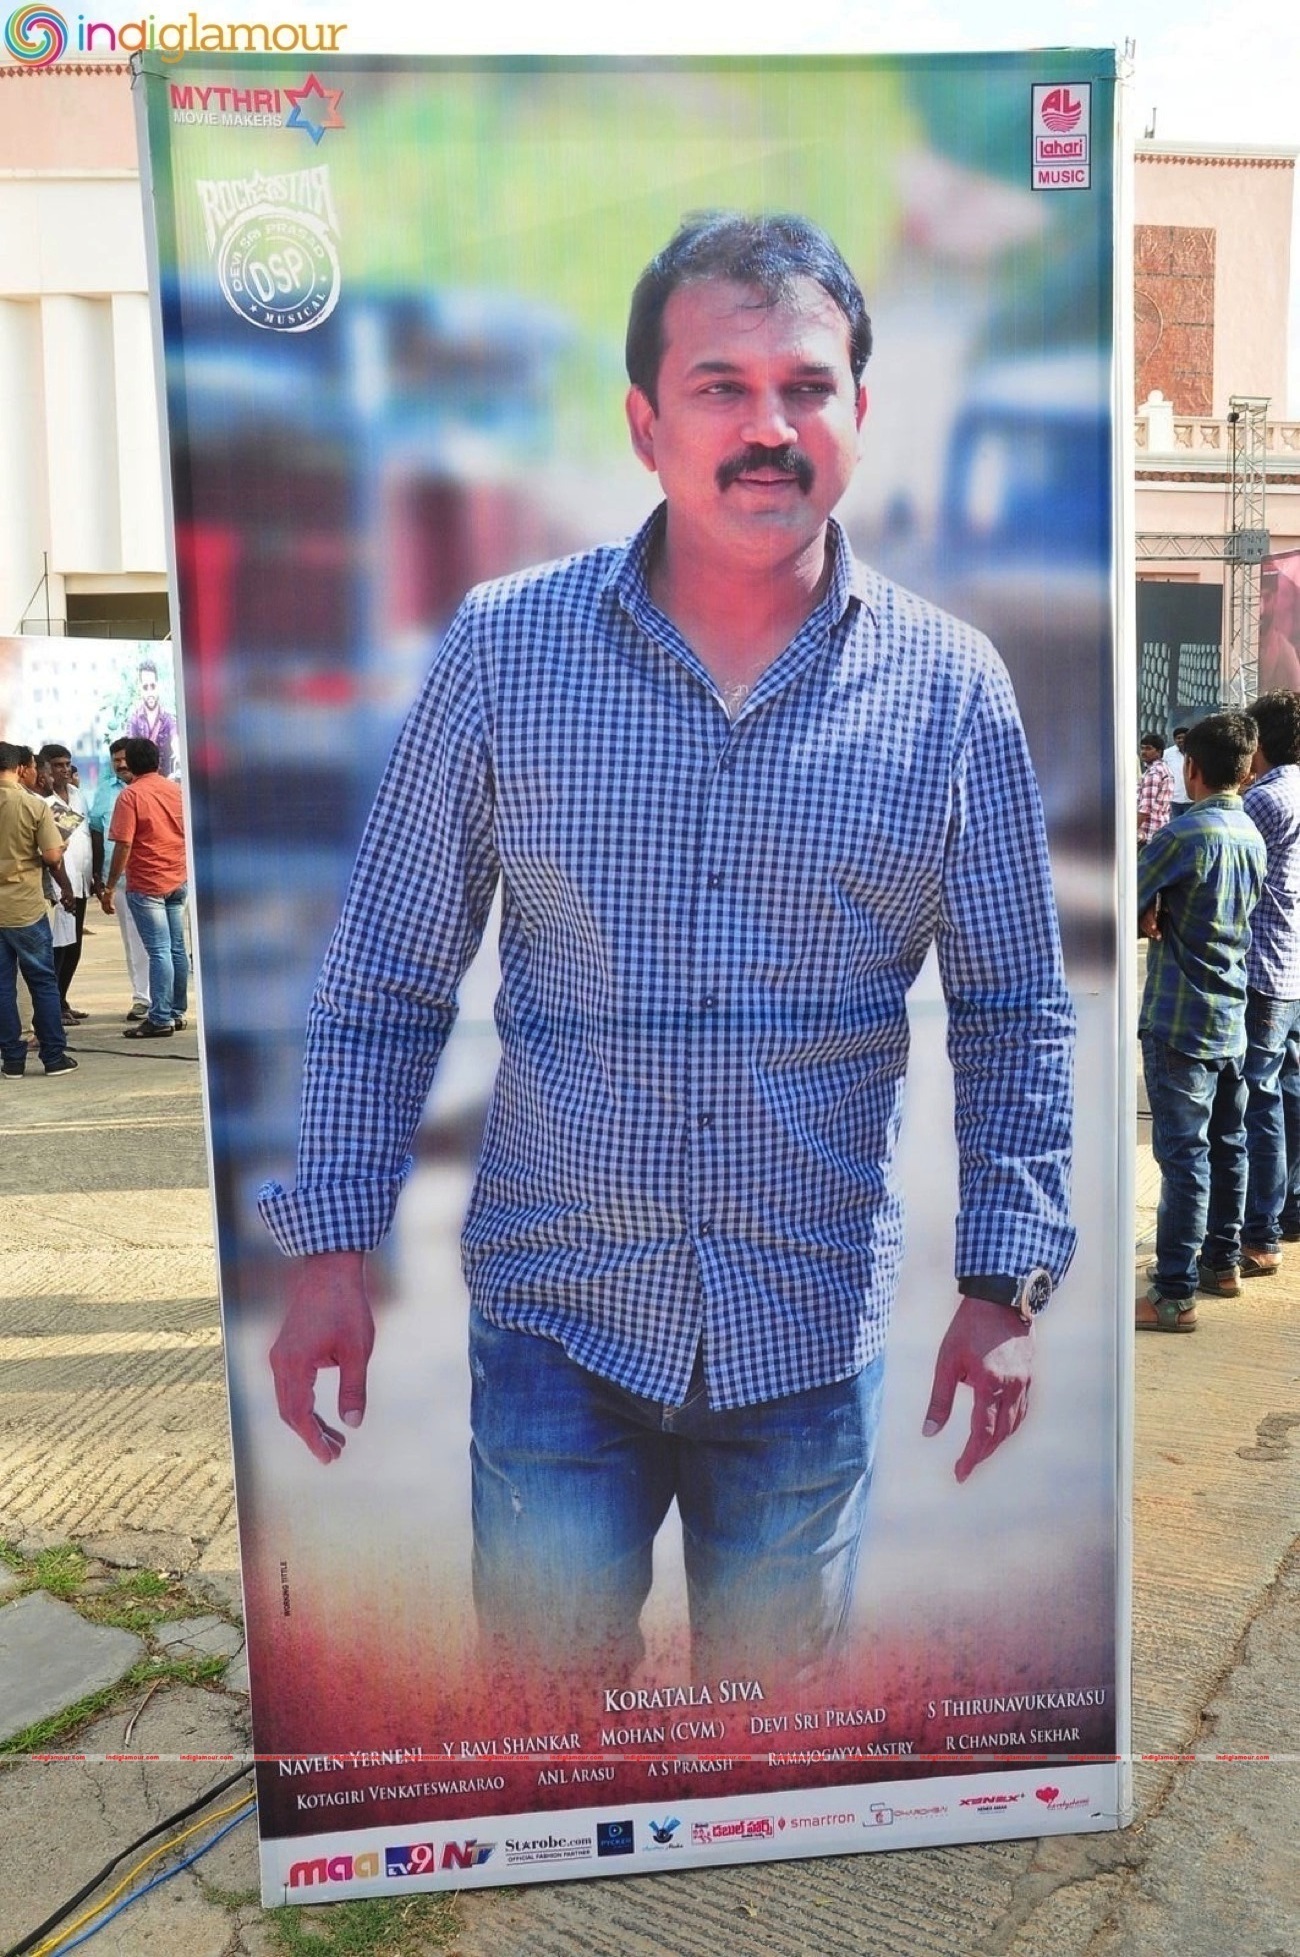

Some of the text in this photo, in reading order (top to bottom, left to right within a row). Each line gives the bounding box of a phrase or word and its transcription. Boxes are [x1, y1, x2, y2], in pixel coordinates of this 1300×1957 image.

[170, 83, 282, 113] MYTHRI
[173, 112, 282, 128] MOVIE MAKERS
[1038, 170, 1085, 183] MUSIC
[230, 251, 243, 292] DEVI
[265, 223, 325, 259] PRASAD
[249, 247, 304, 303] DSP
[264, 293, 326, 325] MUSICAL
[603, 1680, 764, 1712] KORATALA SIVA
[927, 1689, 1105, 1720] S THIRUNAVUKKARASU
[601, 1721, 725, 1746] MOHAN (CVM)
[750, 1708, 886, 1734] DEVI SRI PRASAD
[443, 1733, 581, 1759] Y RAVI SHANKAR
[946, 1727, 1081, 1751] R CHANDRA SEKHAR
[278, 1747, 423, 1776] NAVEEN YERNENI
[768, 1740, 915, 1767] RAMAJOGAYYA SASTRY
[571, 1766, 615, 1782] ARASU
[647, 1758, 733, 1777] A S PRAKASH
[297, 1776, 505, 1810] KOTAGIRI VENKATESWARARAO
[790, 1812, 855, 1829] smartron
[290, 1852, 379, 1887] maa
